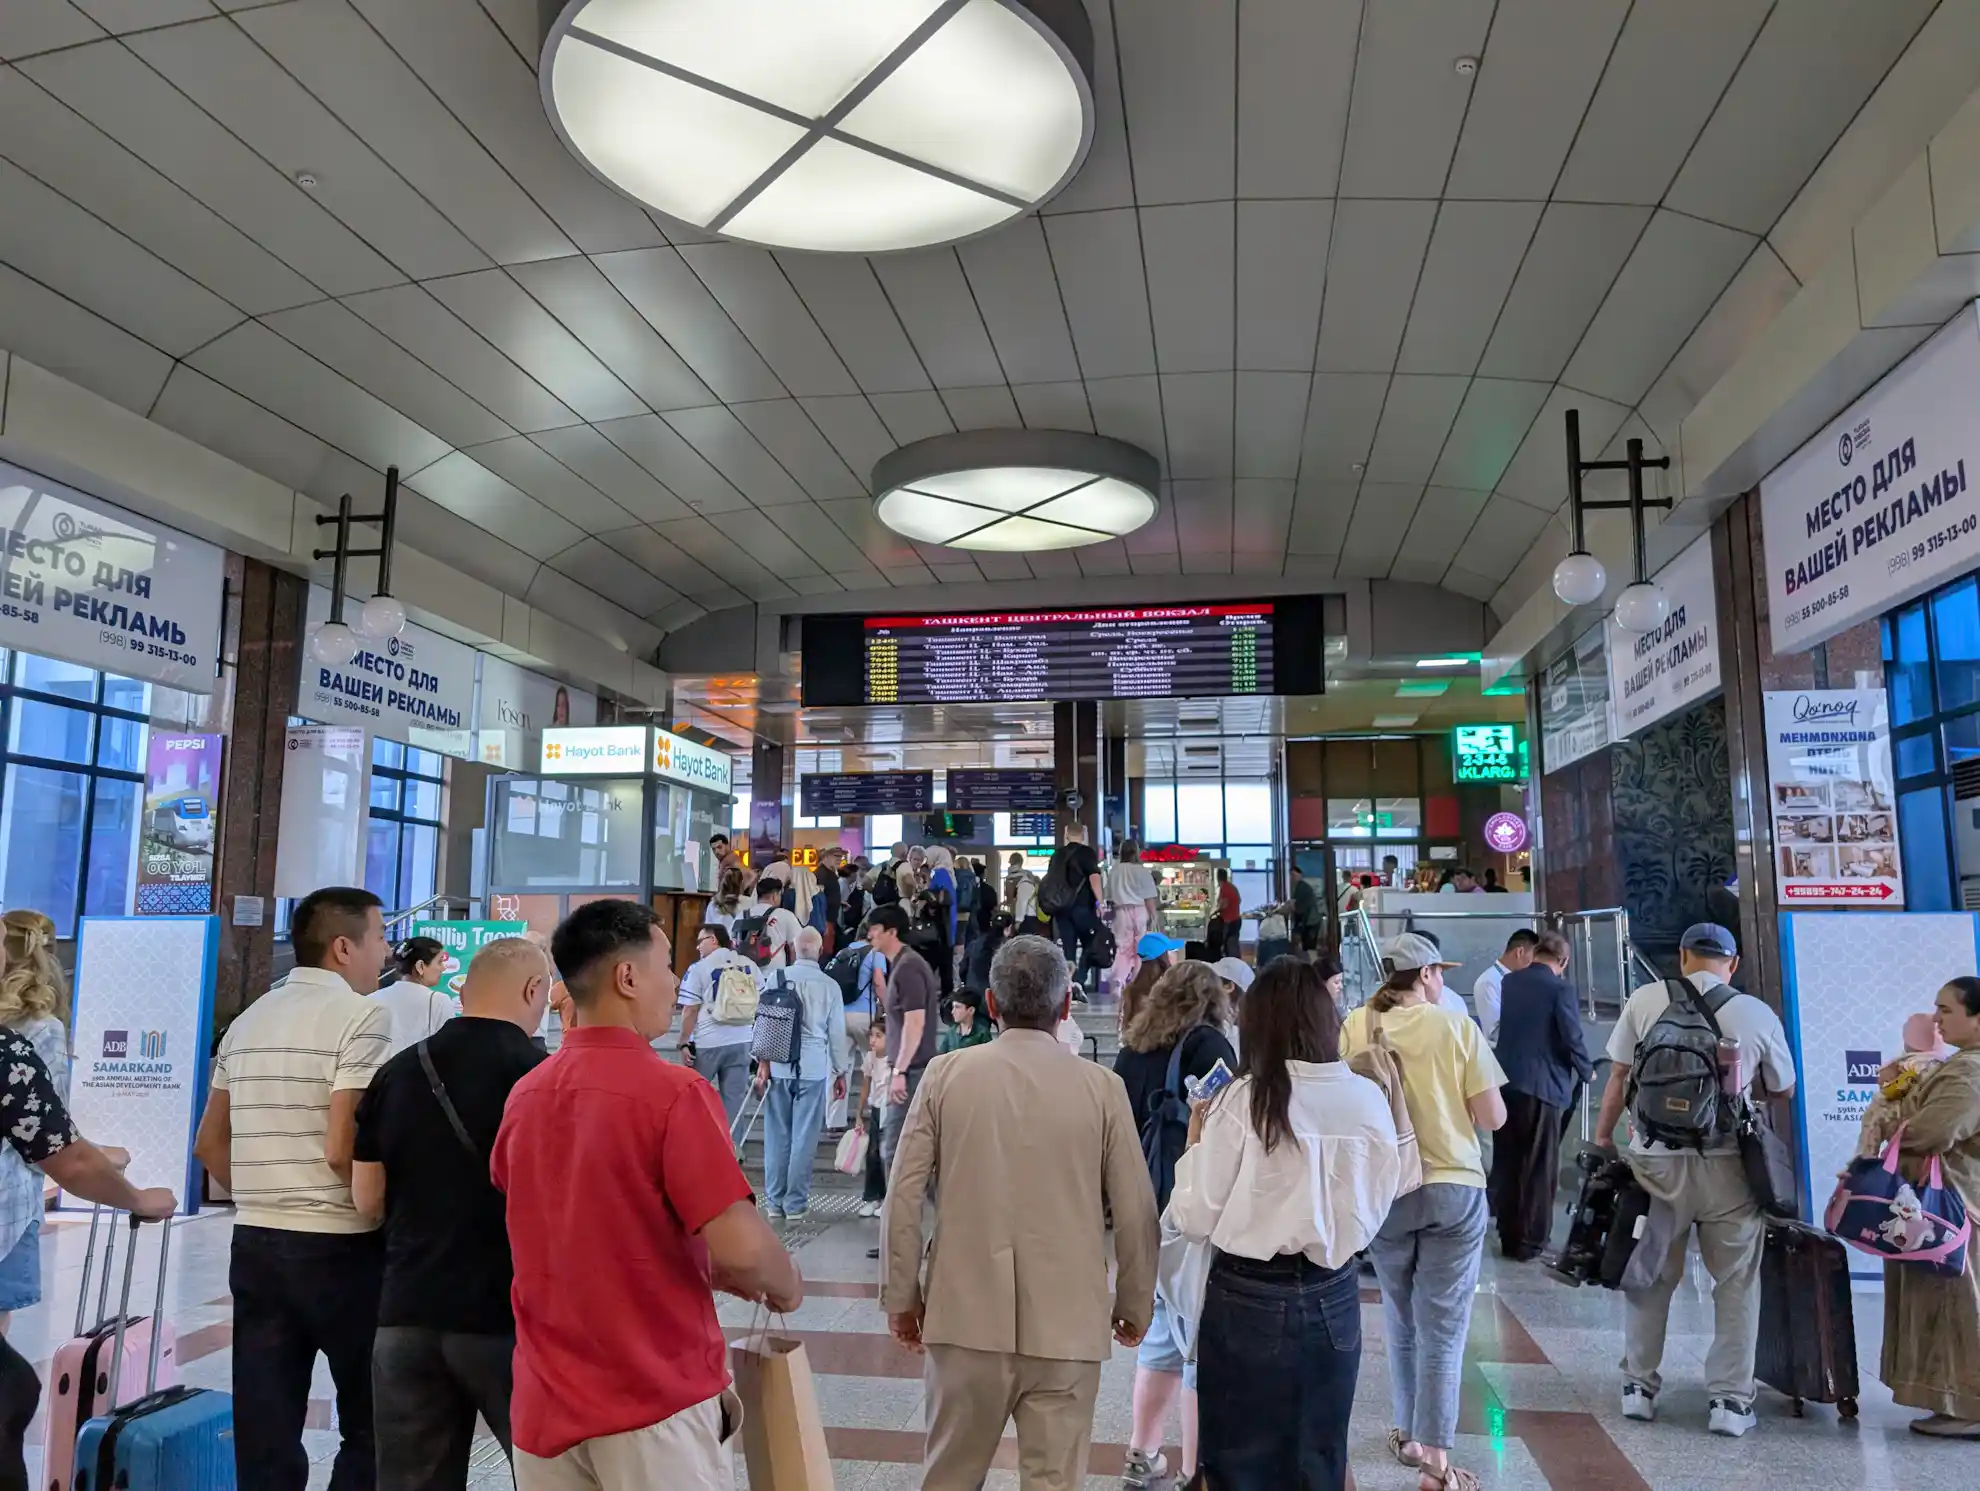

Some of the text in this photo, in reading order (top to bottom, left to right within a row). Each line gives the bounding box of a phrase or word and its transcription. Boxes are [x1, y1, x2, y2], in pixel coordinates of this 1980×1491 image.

[1806, 436, 1916, 539] МЕСТО ДЛЯ
[1784, 458, 1967, 596] ВАШЕЙ РЕКЛАМЫ
[1888, 514, 1978, 577] (998) 99 315-13-00
[0, 527, 86, 576] ЕСТО
[92, 561, 152, 600] ДЛЯ
[922, 608, 1210, 625] ТАШКЕНТ ЦЕНТРАЛЬНЫЙ ВОКЗАЛ
[1634, 605, 1686, 661] МЕСТО ДЛЯ
[99, 629, 196, 666] (998) 99 315-13-00
[1624, 624, 1708, 699] ВАШЕЙ РЕКЛАМЫ
[350, 650, 404, 681] МЕСТО
[408, 668, 438, 694] ДЛЯ
[388, 689, 460, 728] РЕКЛАМЫ
[166, 739, 206, 750] PEPSI
[566, 744, 641, 759] Hayot Bank
[1780, 731, 1876, 743] MEHMONXONA
[673, 747, 729, 784] Hayot Bank
[147, 860, 206, 875] OQ YO'L
[420, 926, 467, 951] Milliy
[103, 1041, 127, 1052] ADB
[93, 1062, 172, 1074] SAMARKAND
